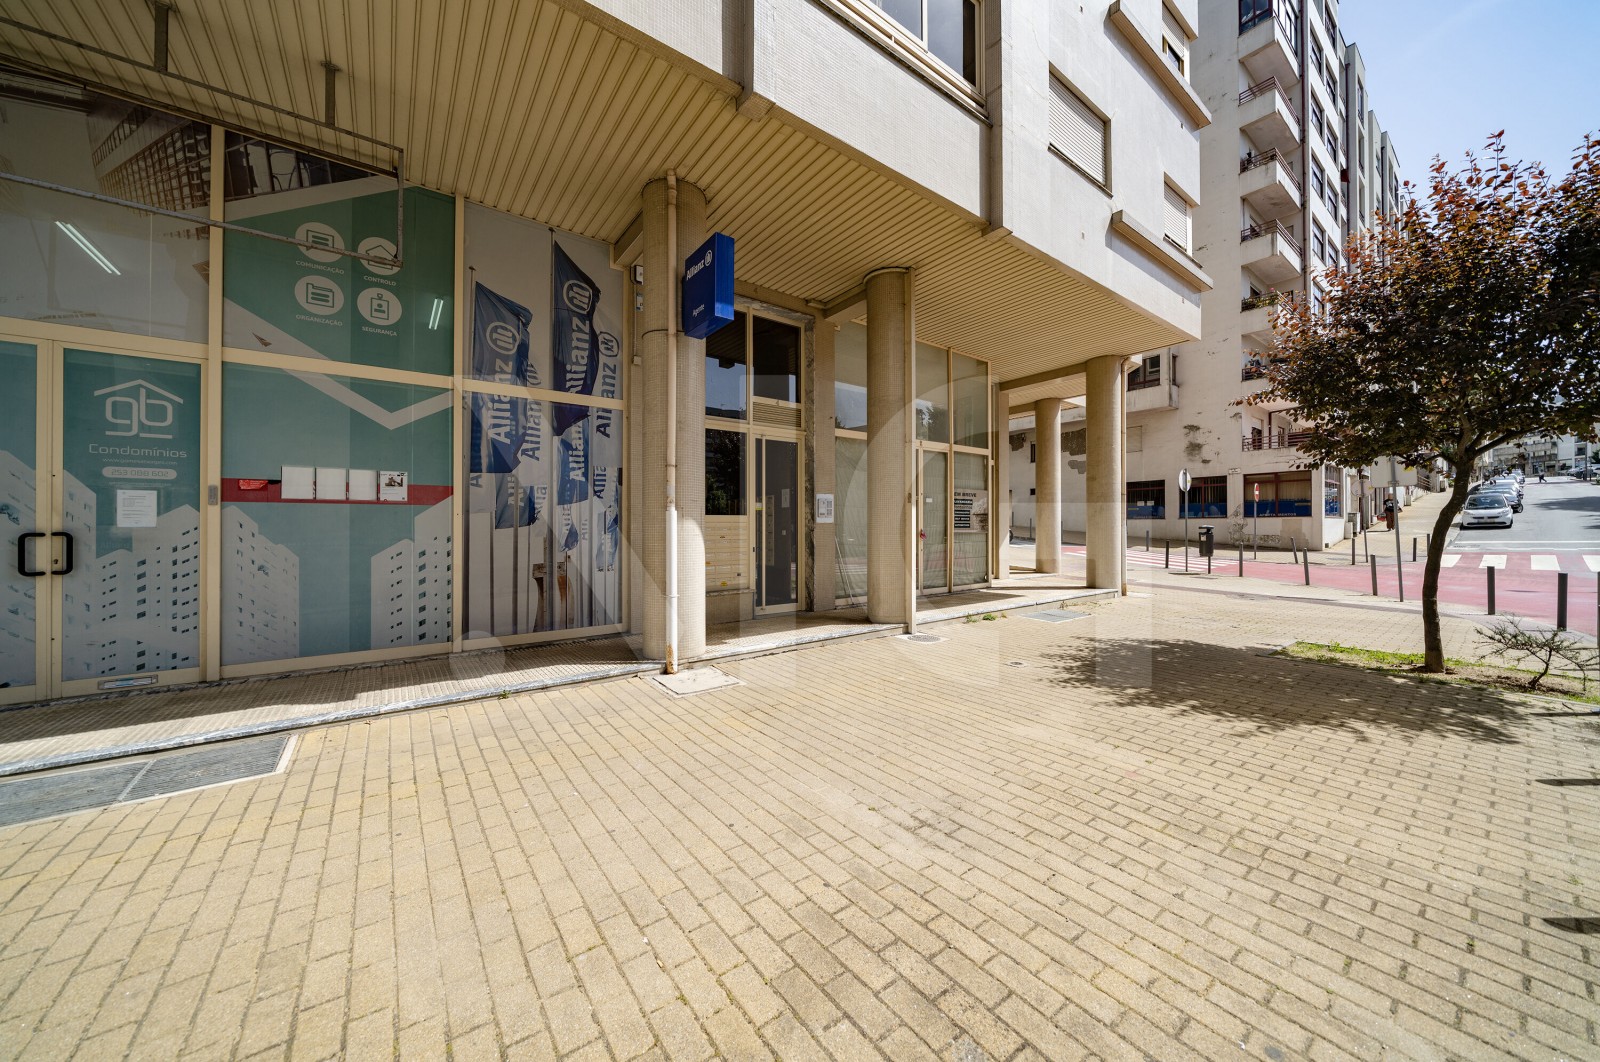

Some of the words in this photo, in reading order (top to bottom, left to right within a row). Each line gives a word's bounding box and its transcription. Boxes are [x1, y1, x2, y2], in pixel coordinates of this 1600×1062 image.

[296, 260, 345, 275] COMUNICAÇÃO
[686, 259, 705, 281] Allianz
[363, 275, 397, 286] CONTROLO
[692, 304, 705, 317] Agente
[295, 314, 343, 327] ORGANIZAÇÃO
[361, 326, 398, 337] SEGURANÇA
[596, 362, 616, 438] Allanz
[521, 400, 542, 461] Allian
[88, 443, 187, 458] Condomínios
